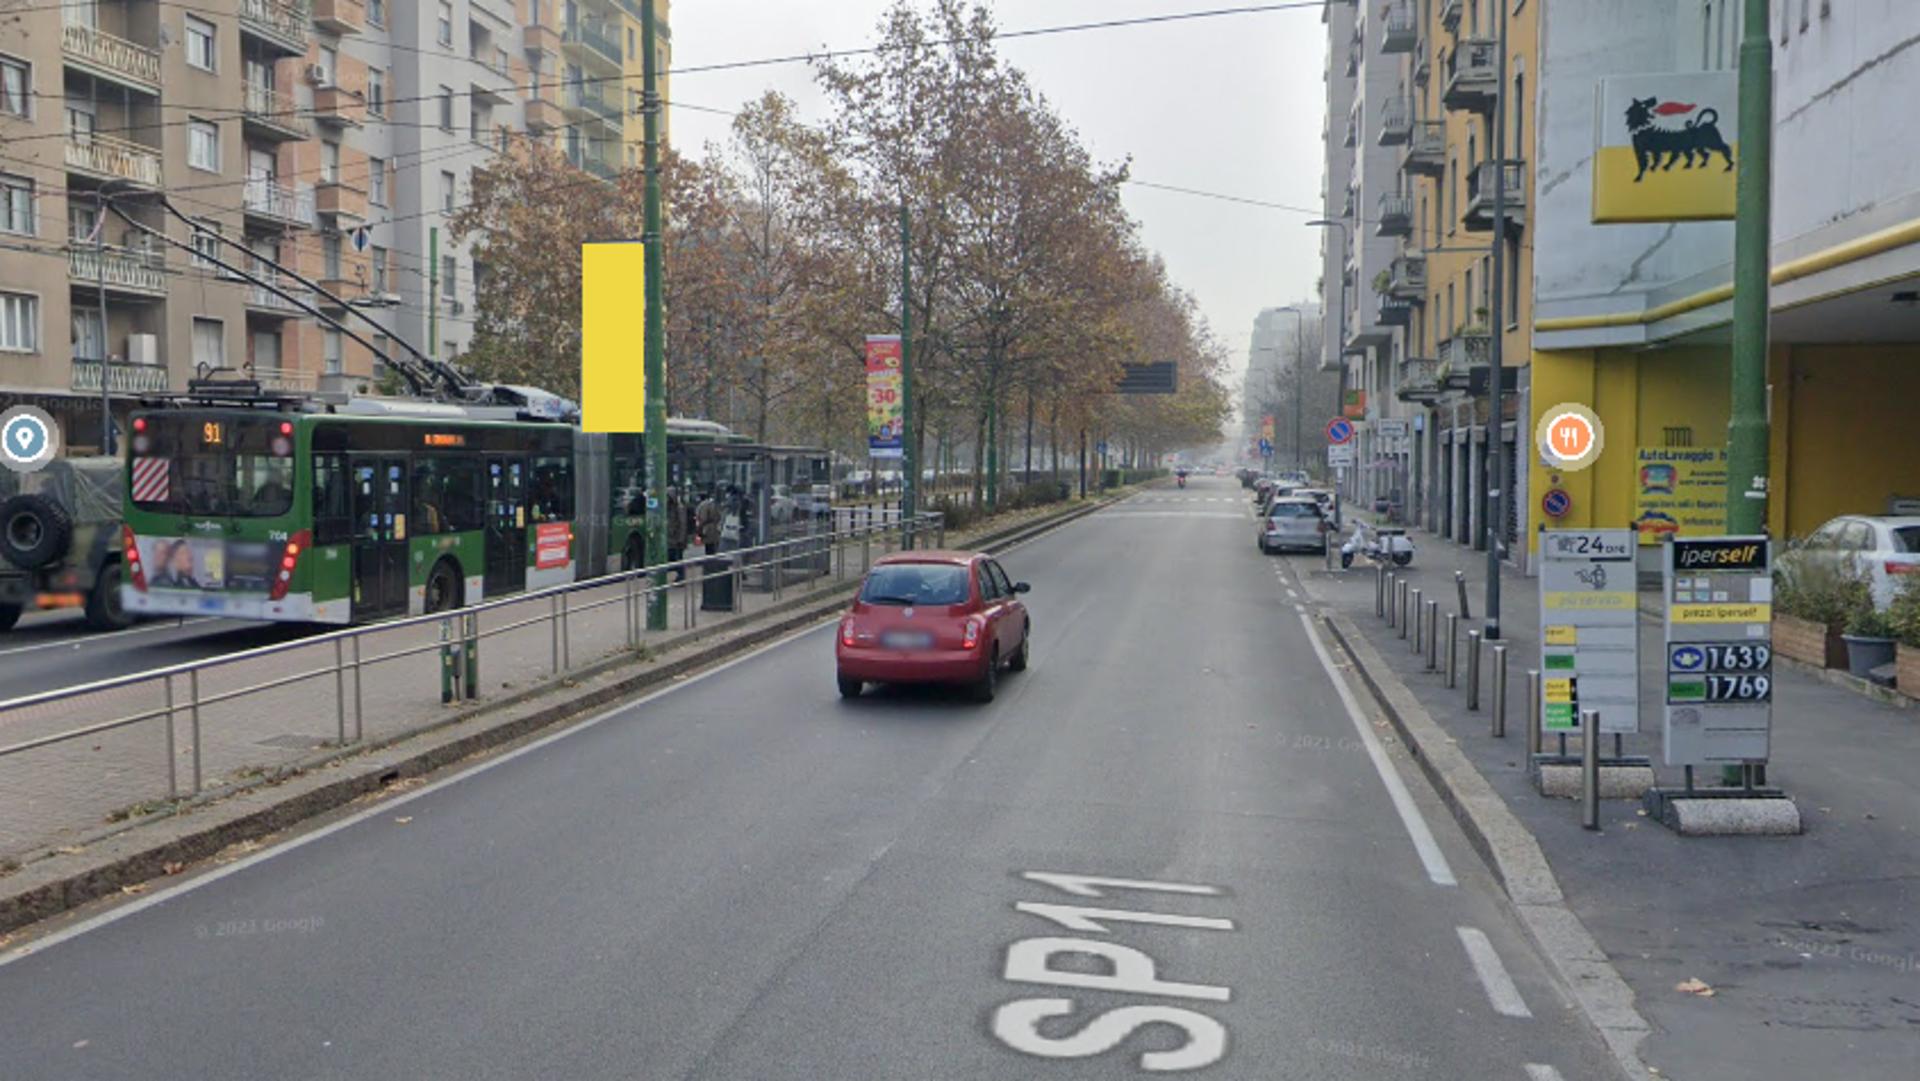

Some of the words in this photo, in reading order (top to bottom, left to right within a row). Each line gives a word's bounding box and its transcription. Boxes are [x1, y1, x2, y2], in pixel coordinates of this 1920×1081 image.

[204, 422, 222, 443] 91
[1640, 449, 1714, 463] AutoLavaggio
[1576, 536, 1604, 554] 24
[1681, 544, 1759, 567] iperself
[1683, 607, 1714, 619] prezzi
[1717, 606, 1757, 618] iperself
[1708, 646, 1770, 670] 1639
[1708, 676, 1770, 700] 1769
[992, 870, 1236, 1071] SP11
